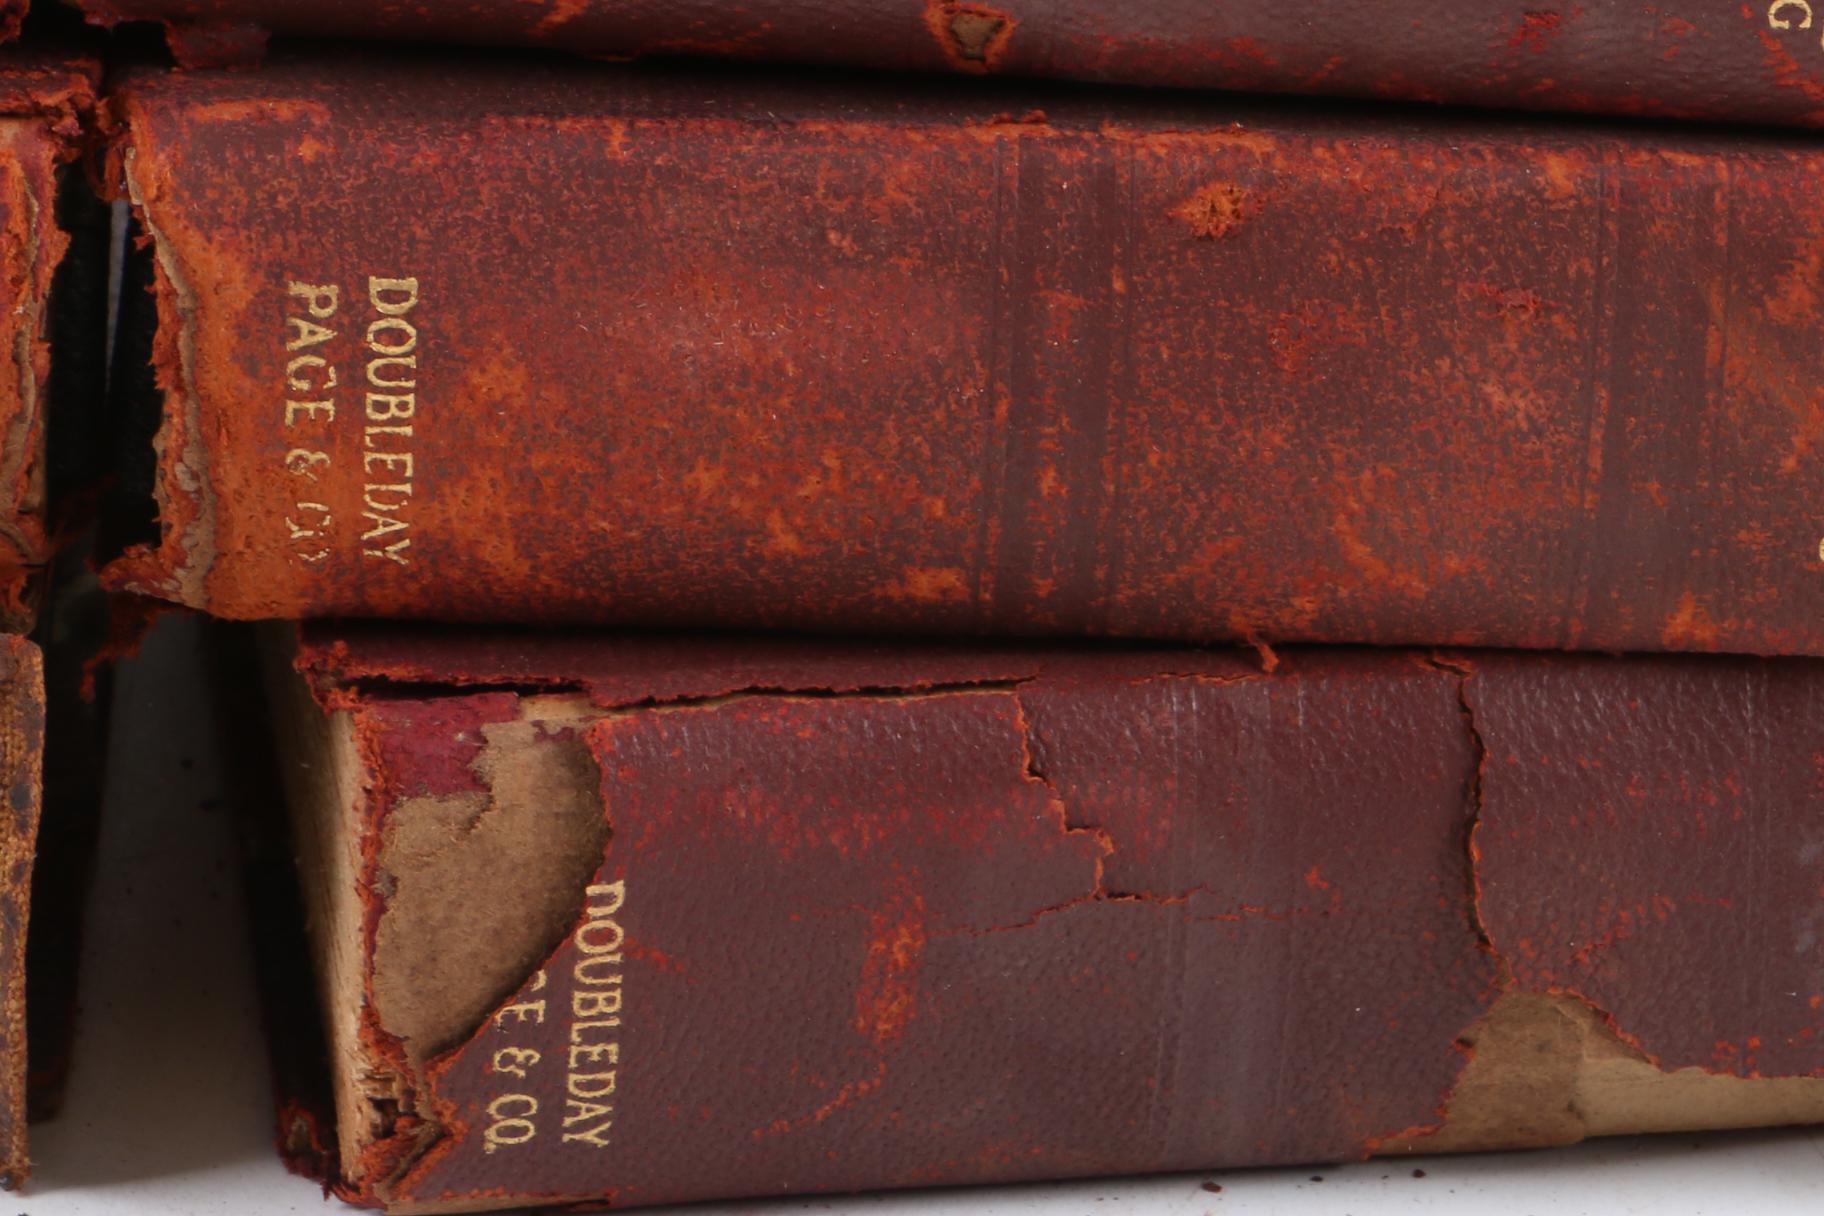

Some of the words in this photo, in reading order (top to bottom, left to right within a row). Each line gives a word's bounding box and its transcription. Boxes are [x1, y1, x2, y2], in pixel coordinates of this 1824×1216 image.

[285, 281, 339, 428] PAGE
[285, 448, 332, 483] &
[360, 276, 418, 565] DOUBLEDAY
[492, 1046, 541, 1079] &
[562, 880, 625, 1147] DOUBLEDAY
[483, 1094, 537, 1154] CO.
